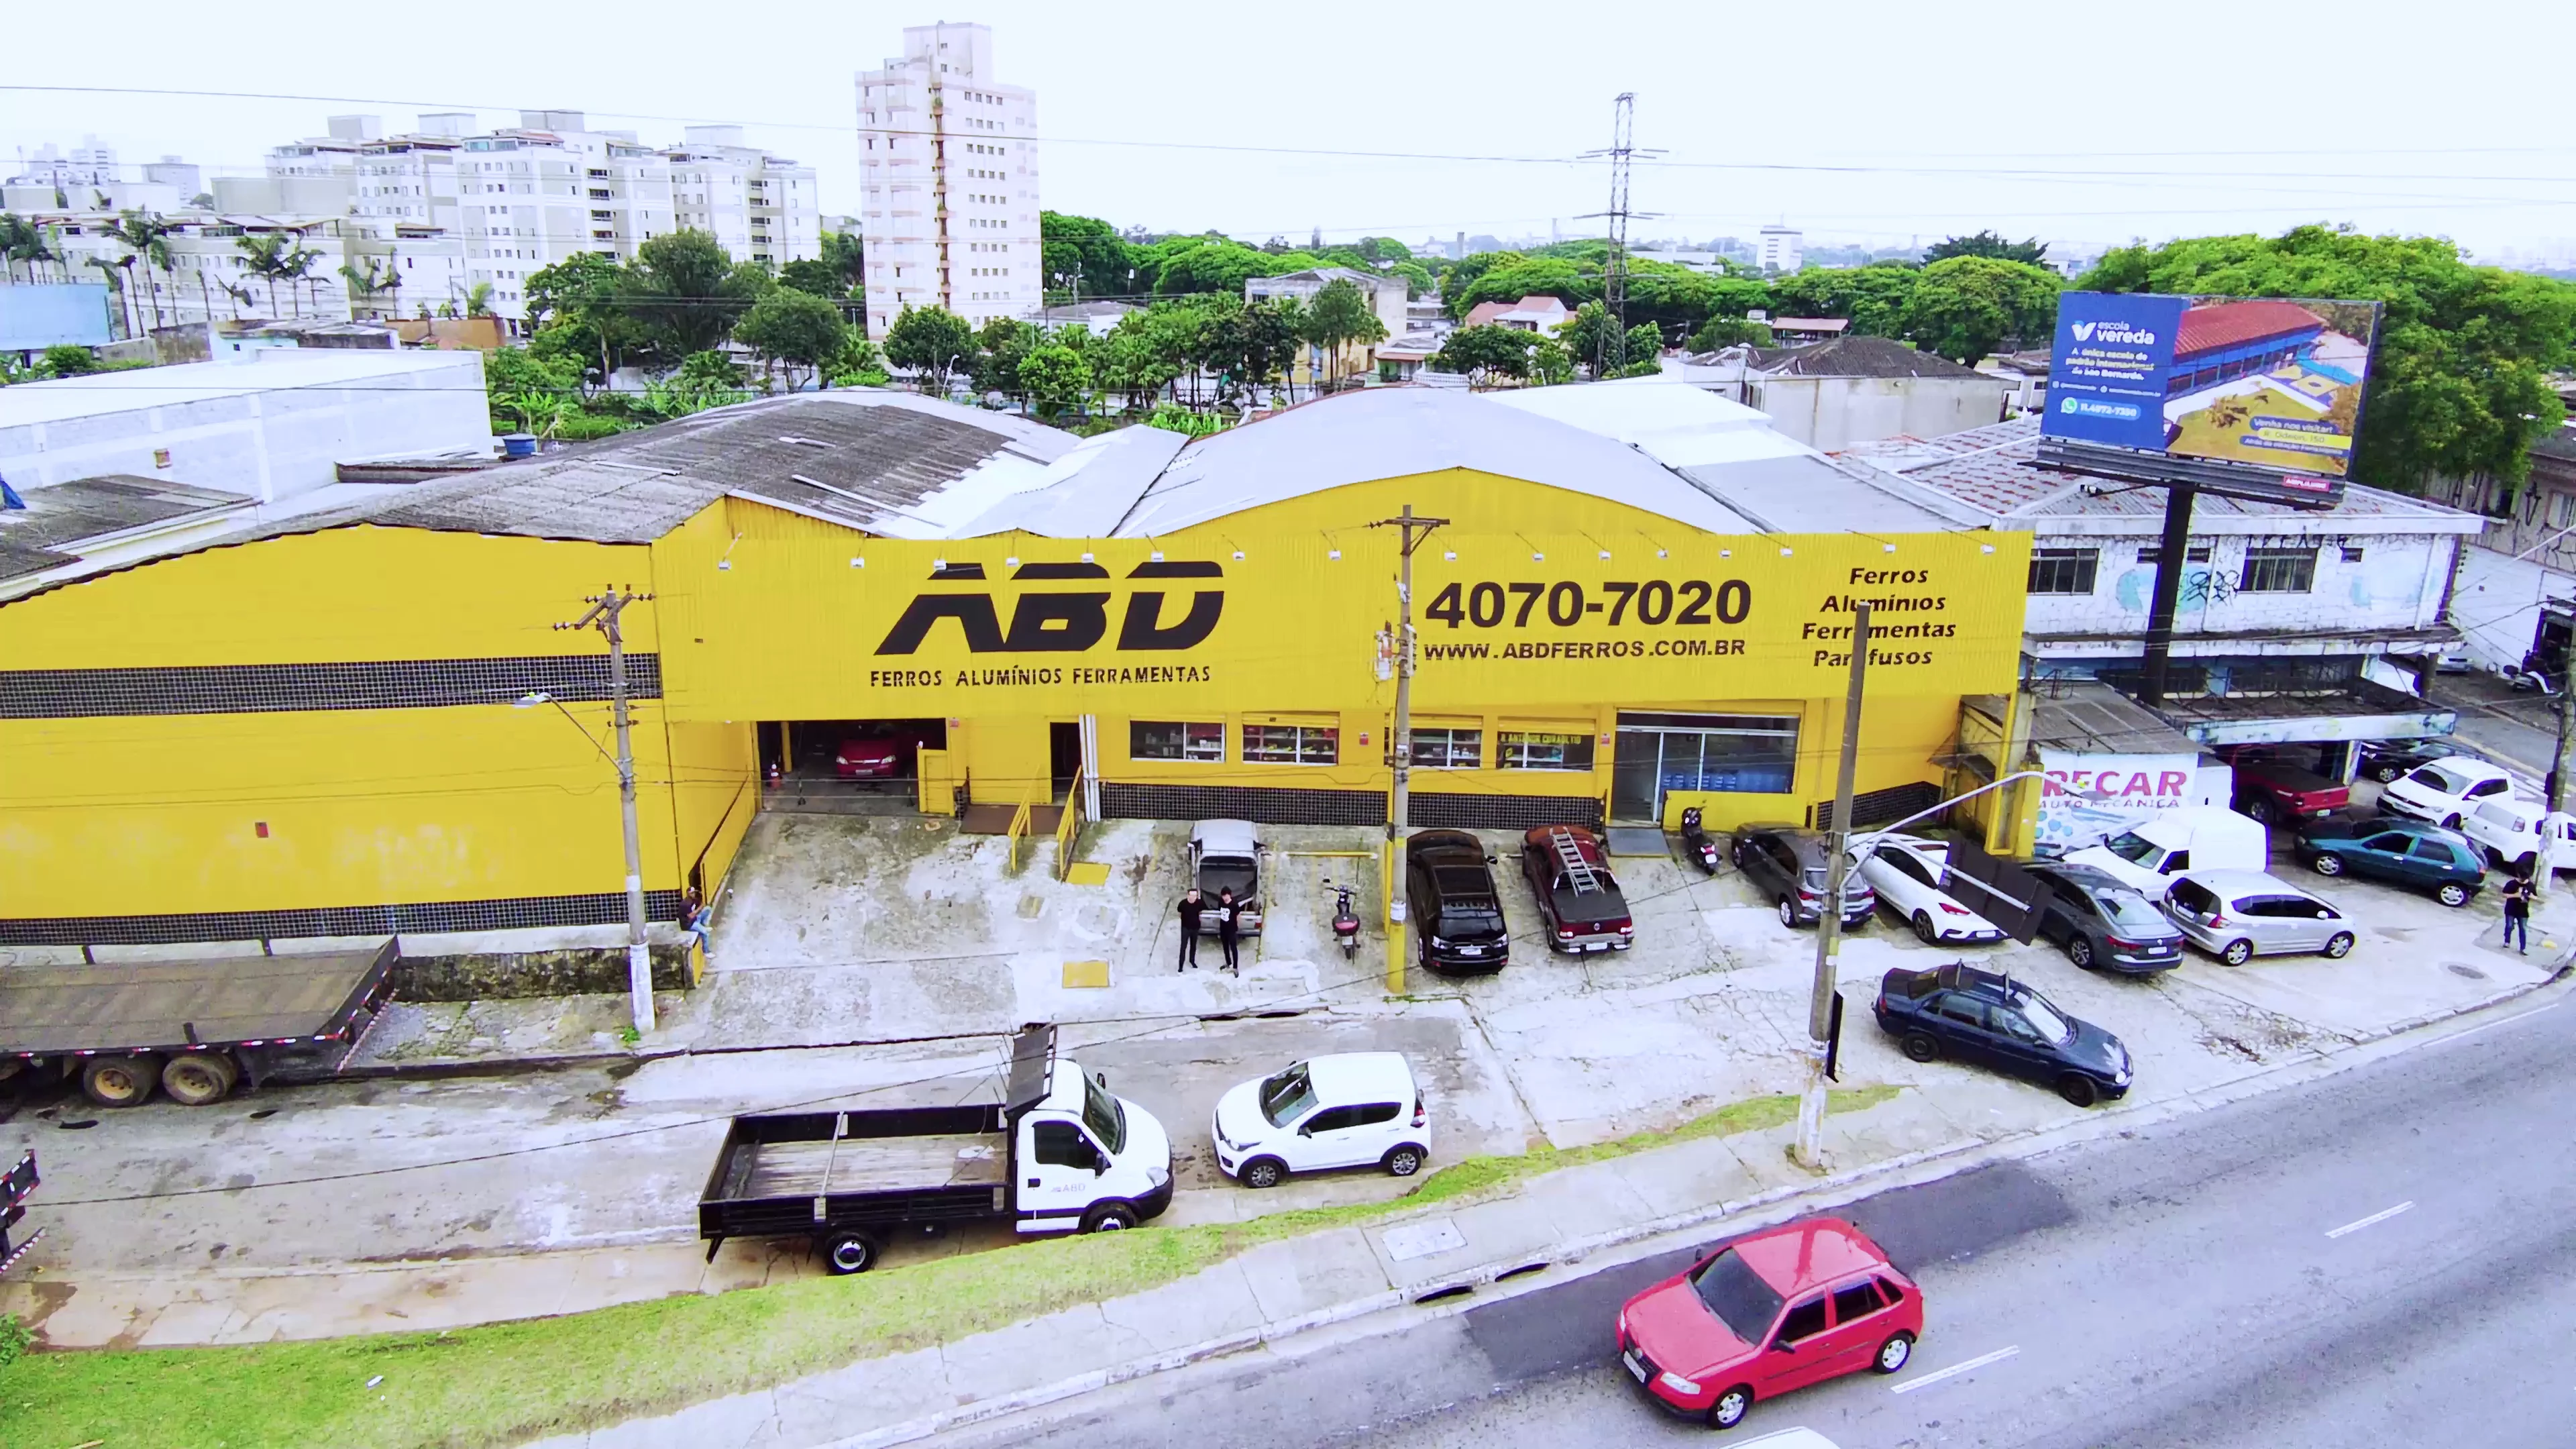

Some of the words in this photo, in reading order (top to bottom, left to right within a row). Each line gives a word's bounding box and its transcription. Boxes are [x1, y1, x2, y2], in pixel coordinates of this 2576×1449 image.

[2098, 321, 2130, 331] escola
[2096, 329, 2155, 345] vereda
[1849, 568, 1929, 584] Ferros
[873, 561, 1224, 655] ABD
[1426, 580, 1751, 629] 4070-7020
[1803, 622, 1956, 639] Ferrmentas
[1814, 648, 1933, 667] Parfusos
[871, 670, 942, 687] FERROS
[956, 665, 1062, 686] ALUMÍNIOS
[1073, 666, 1211, 684] FERRAMENTAS
[2039, 800, 2082, 809] AUTO
[1062, 1183, 1085, 1192] ABD
